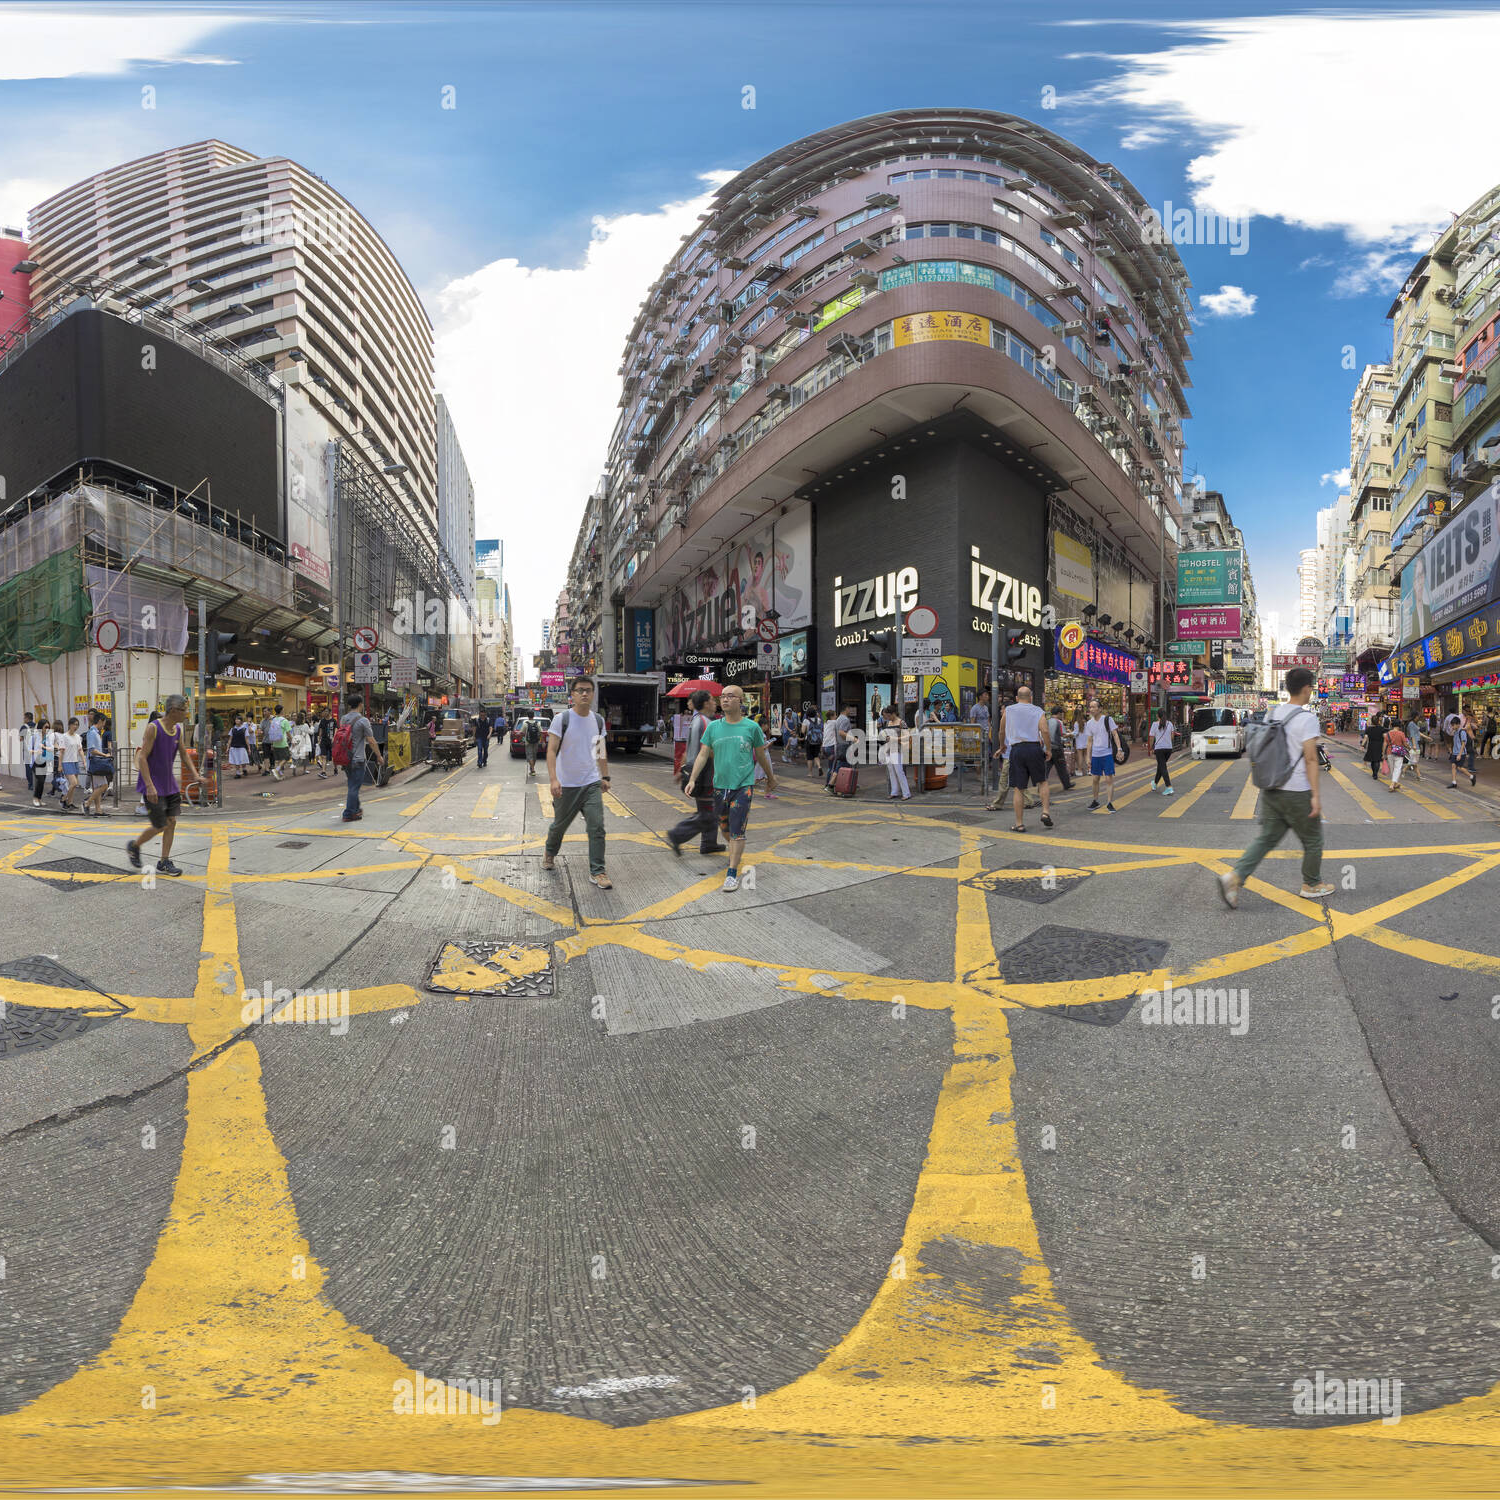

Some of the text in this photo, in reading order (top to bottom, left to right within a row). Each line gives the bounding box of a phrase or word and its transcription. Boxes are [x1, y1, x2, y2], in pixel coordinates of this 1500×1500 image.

[1430, 508, 1480, 593] IELTS
[1190, 559, 1221, 567] HOSTEL
[971, 545, 1043, 628] izzue
[834, 566, 919, 628] izzue
[636, 621, 650, 637] i.t
[236, 666, 277, 684] mannings
[737, 661, 748, 672] CITY
[699, 672, 715, 682] TISSOT
